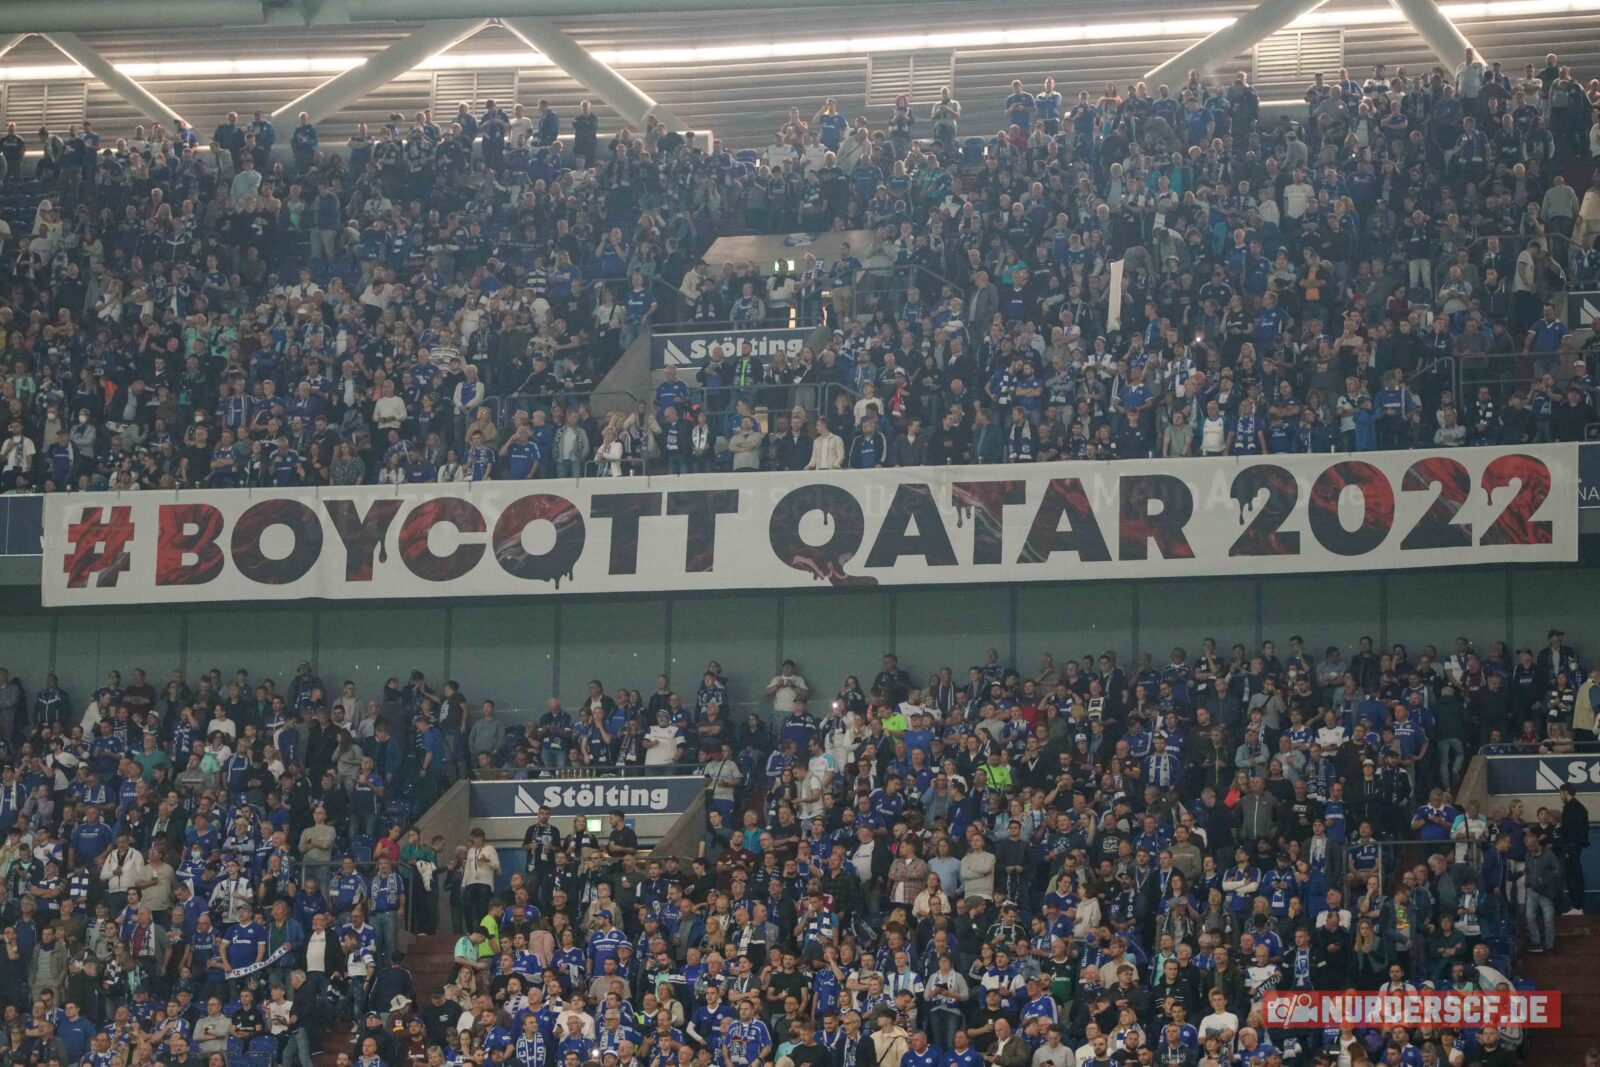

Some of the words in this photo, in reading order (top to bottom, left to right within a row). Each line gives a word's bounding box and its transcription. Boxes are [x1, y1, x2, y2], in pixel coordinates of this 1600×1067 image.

[62, 488, 740, 590] #BOYCOTT
[769, 475, 1195, 586] QATAR
[1228, 454, 1553, 557] 2022
[543, 784, 669, 810] Stölting
